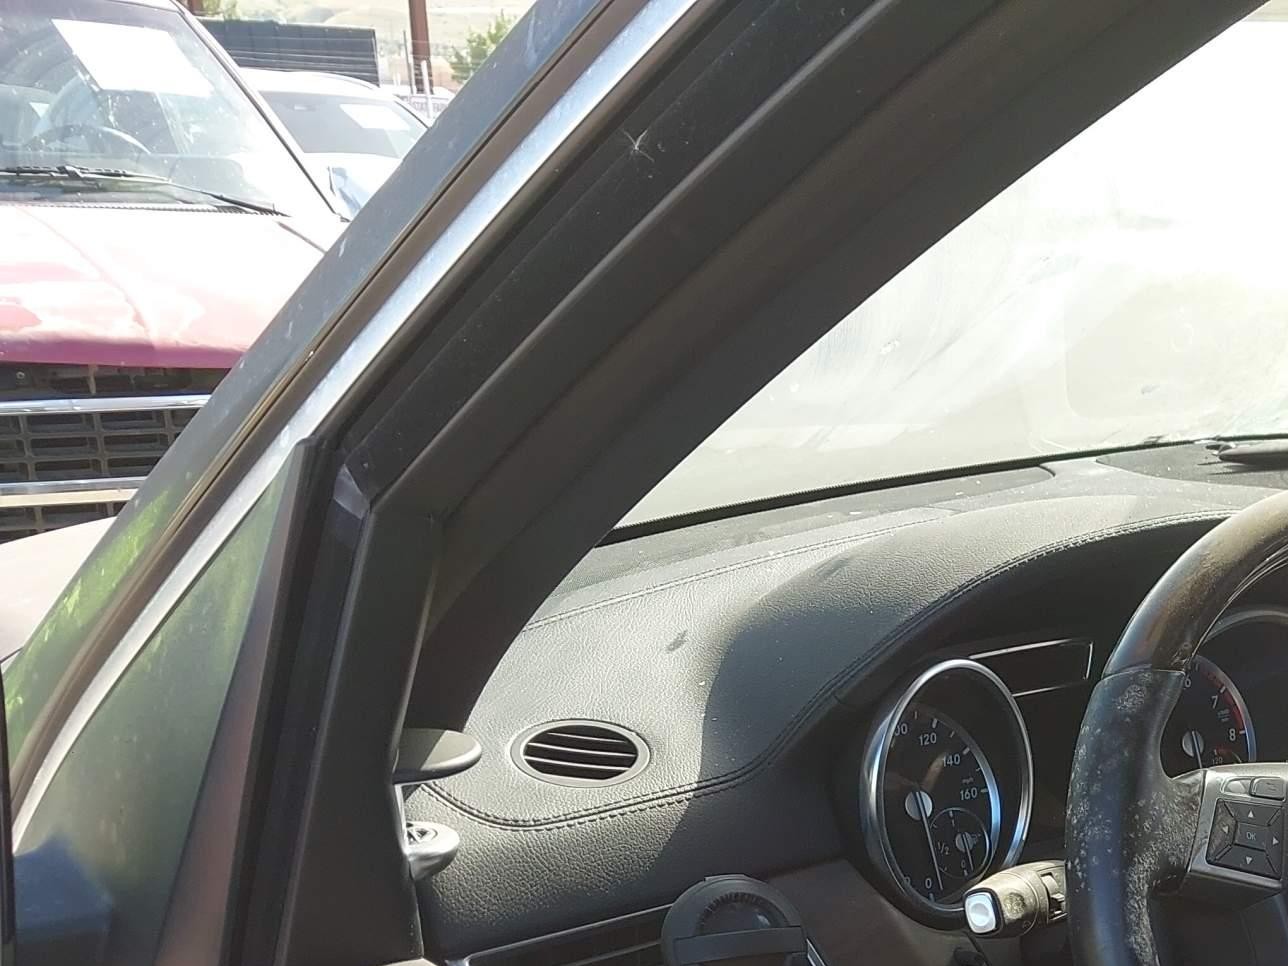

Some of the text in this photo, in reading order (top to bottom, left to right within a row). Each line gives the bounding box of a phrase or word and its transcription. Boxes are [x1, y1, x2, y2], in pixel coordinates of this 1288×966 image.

[1211, 695, 1219, 709] 7
[919, 732, 937, 746] 120
[1229, 728, 1236, 742] 8
[943, 754, 961, 767] 140
[960, 787, 978, 801] 160
[1246, 831, 1257, 841] OK
[924, 878, 933, 889] 0
